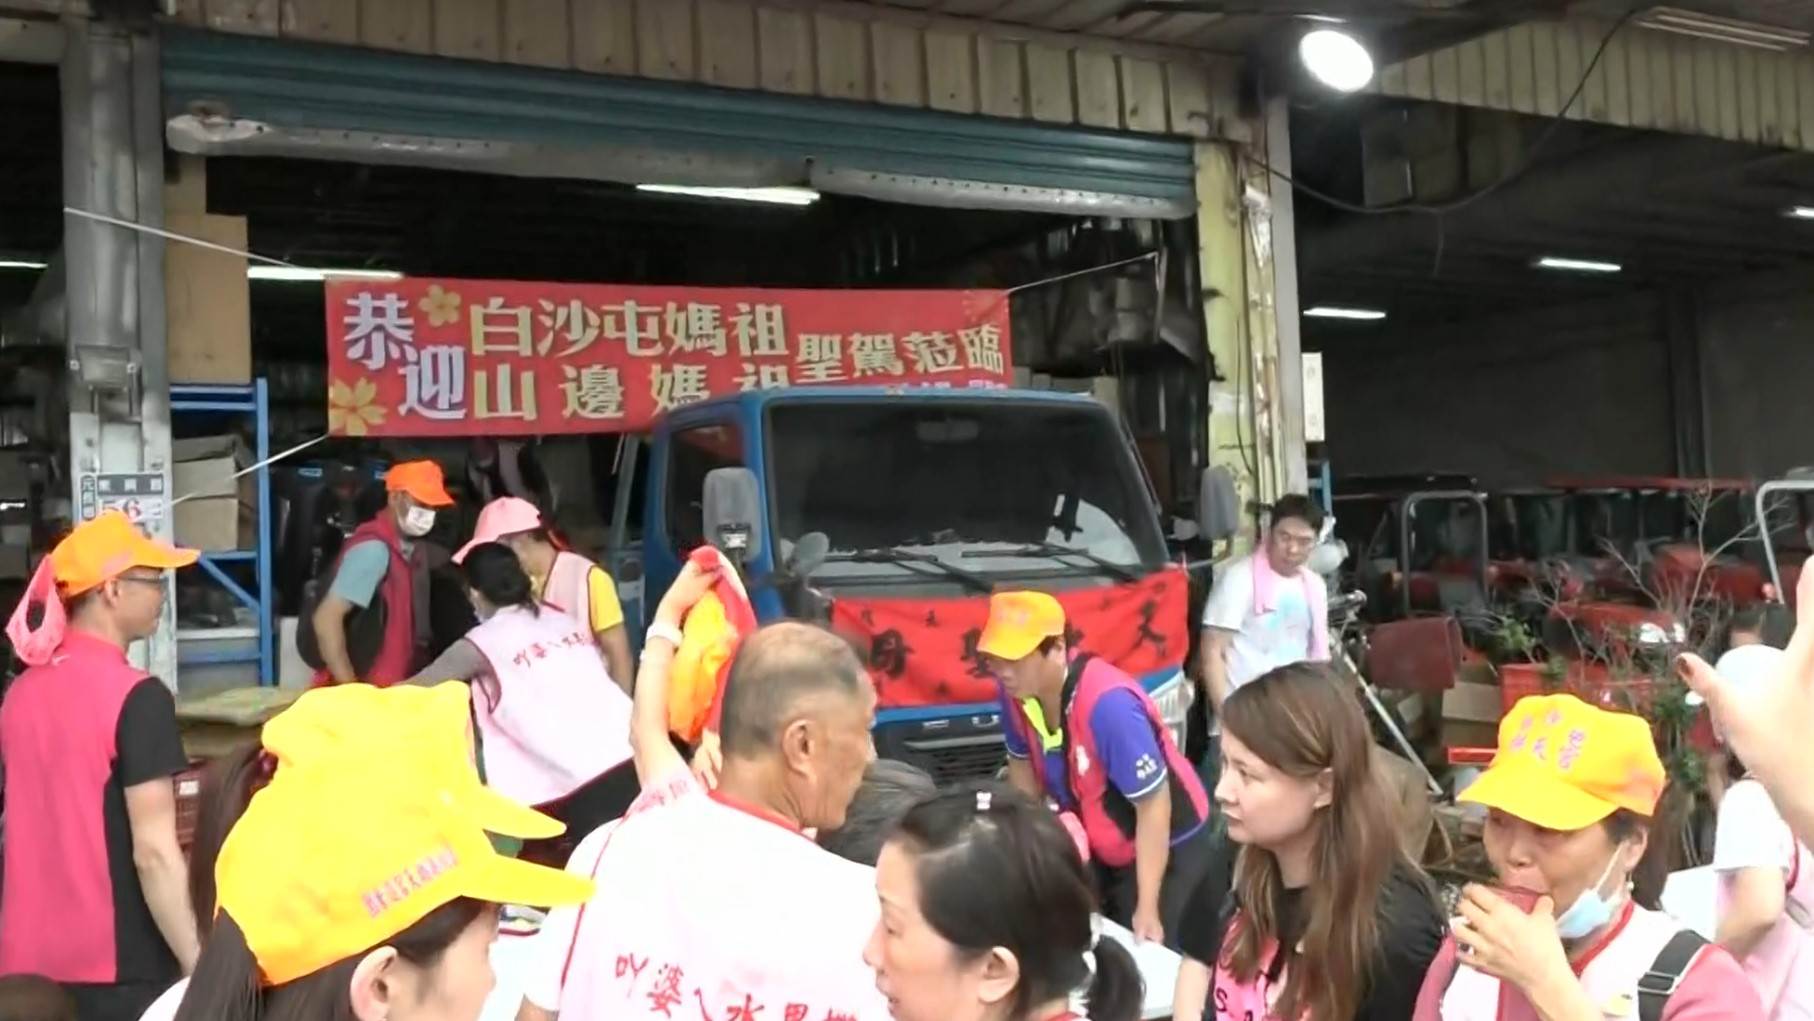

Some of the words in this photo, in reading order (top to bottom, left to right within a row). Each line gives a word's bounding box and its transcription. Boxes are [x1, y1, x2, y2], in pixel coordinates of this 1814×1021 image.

[343, 291, 467, 420] 恭迎
[469, 297, 789, 357] 白沙屯媽祖
